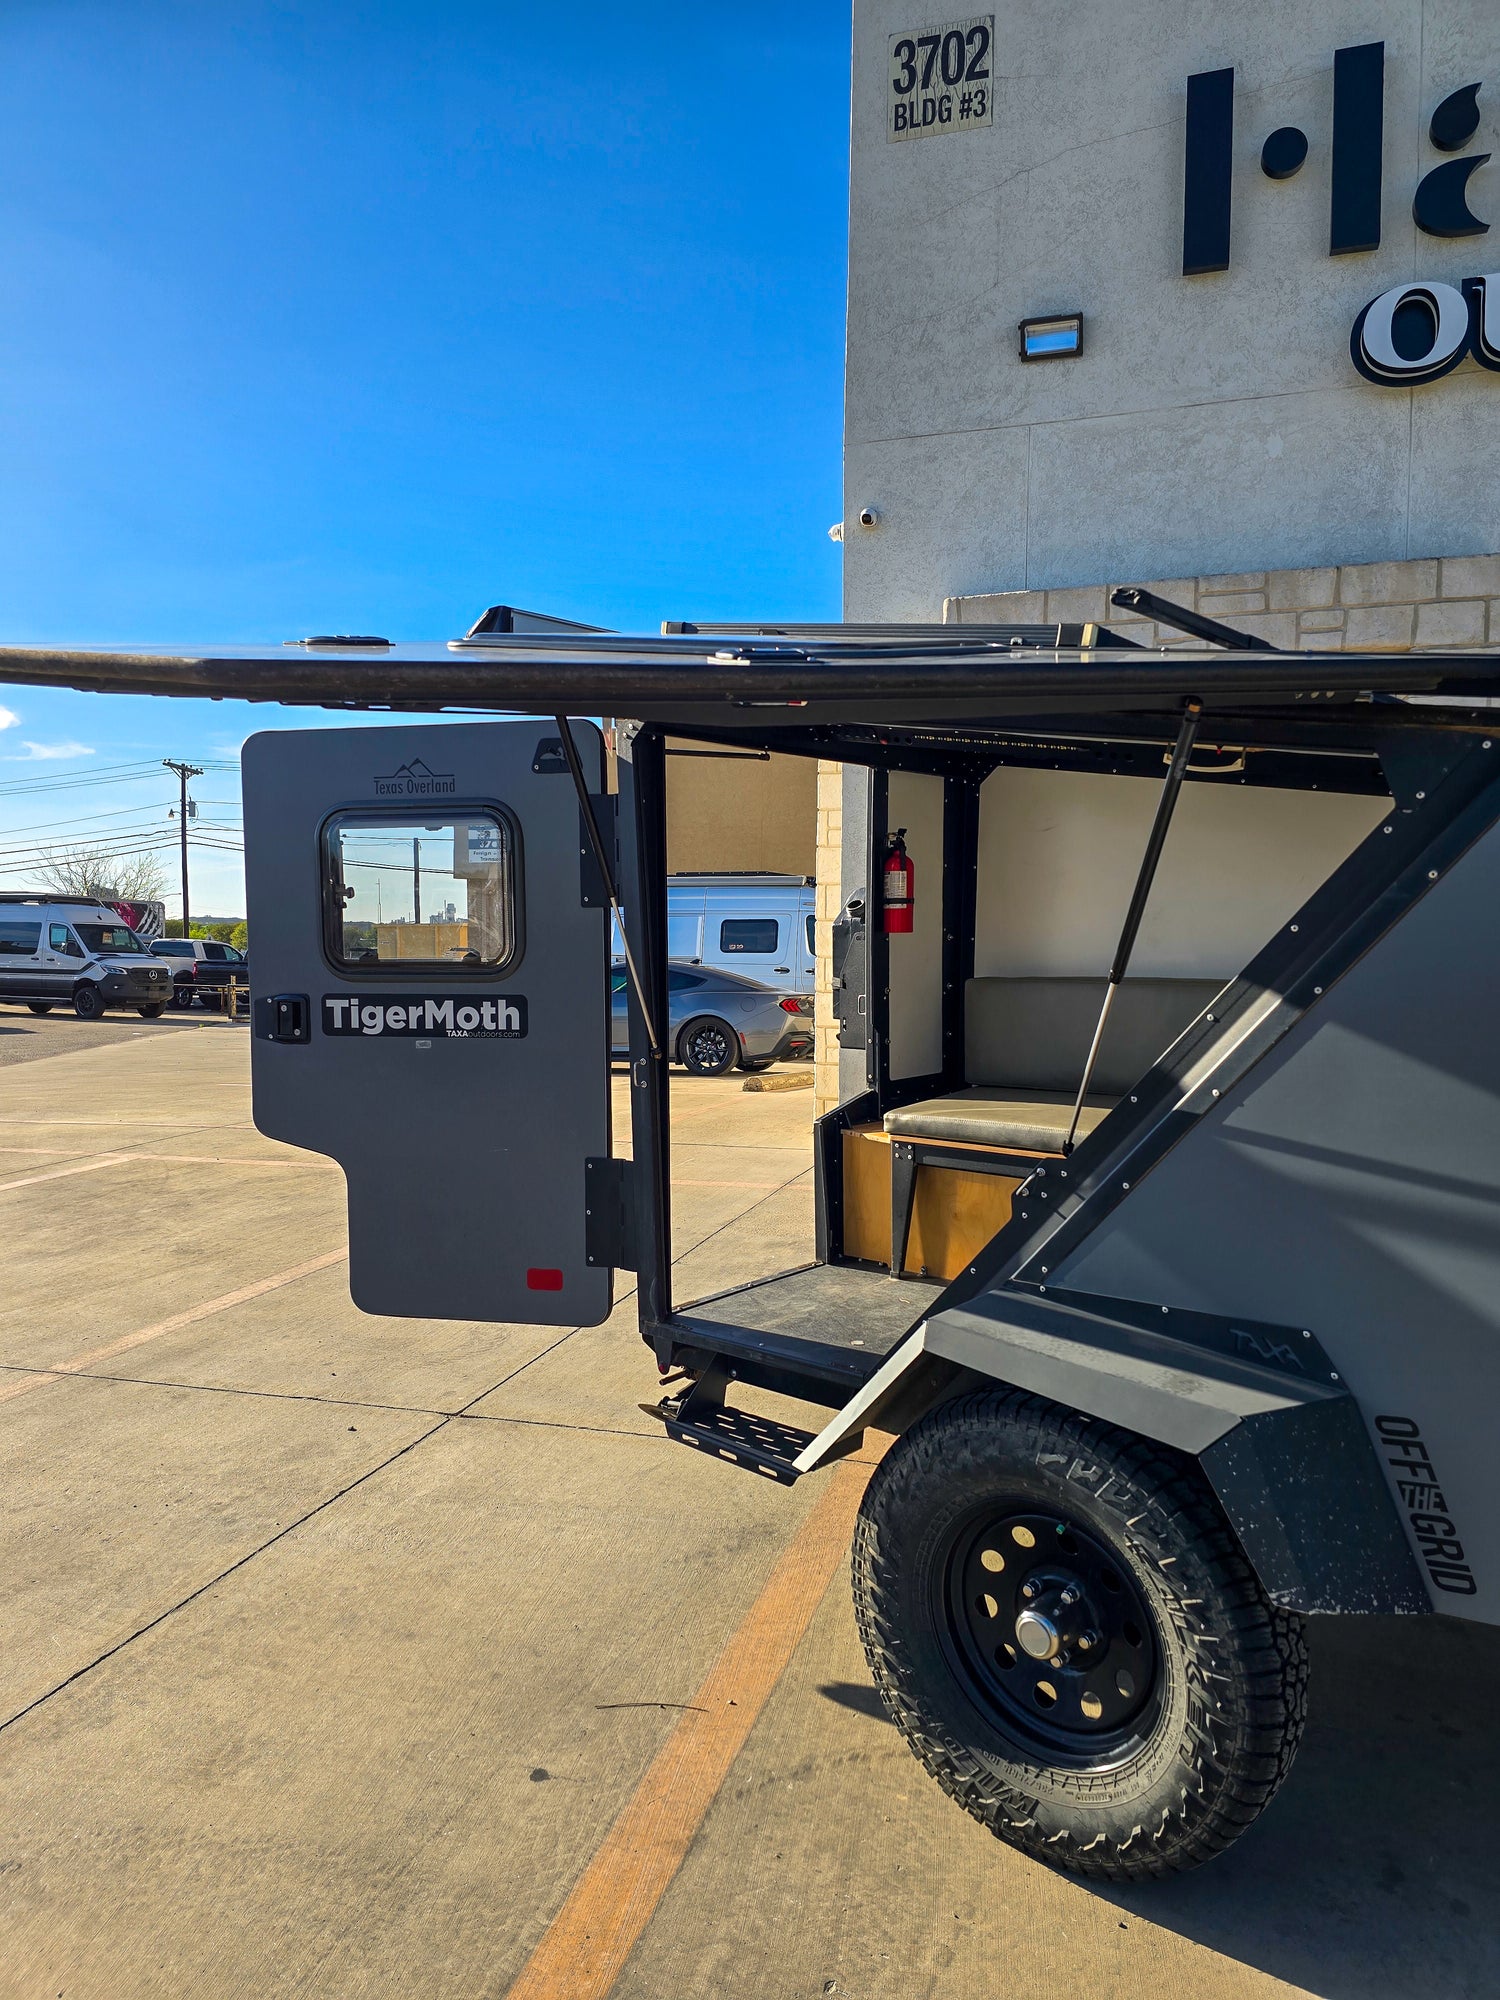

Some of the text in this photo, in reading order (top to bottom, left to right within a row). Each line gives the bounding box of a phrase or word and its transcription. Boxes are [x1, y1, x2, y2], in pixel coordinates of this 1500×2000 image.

[892, 25, 990, 95] 3702
[894, 89, 987, 132] BLDG #3
[373, 778, 456, 795] Texas Overland
[325, 998, 521, 1035] TigerMoth
[446, 1030, 520, 1038] TAXAoutdoors.com
[1374, 1414, 1478, 1596] OFF THE GRID
